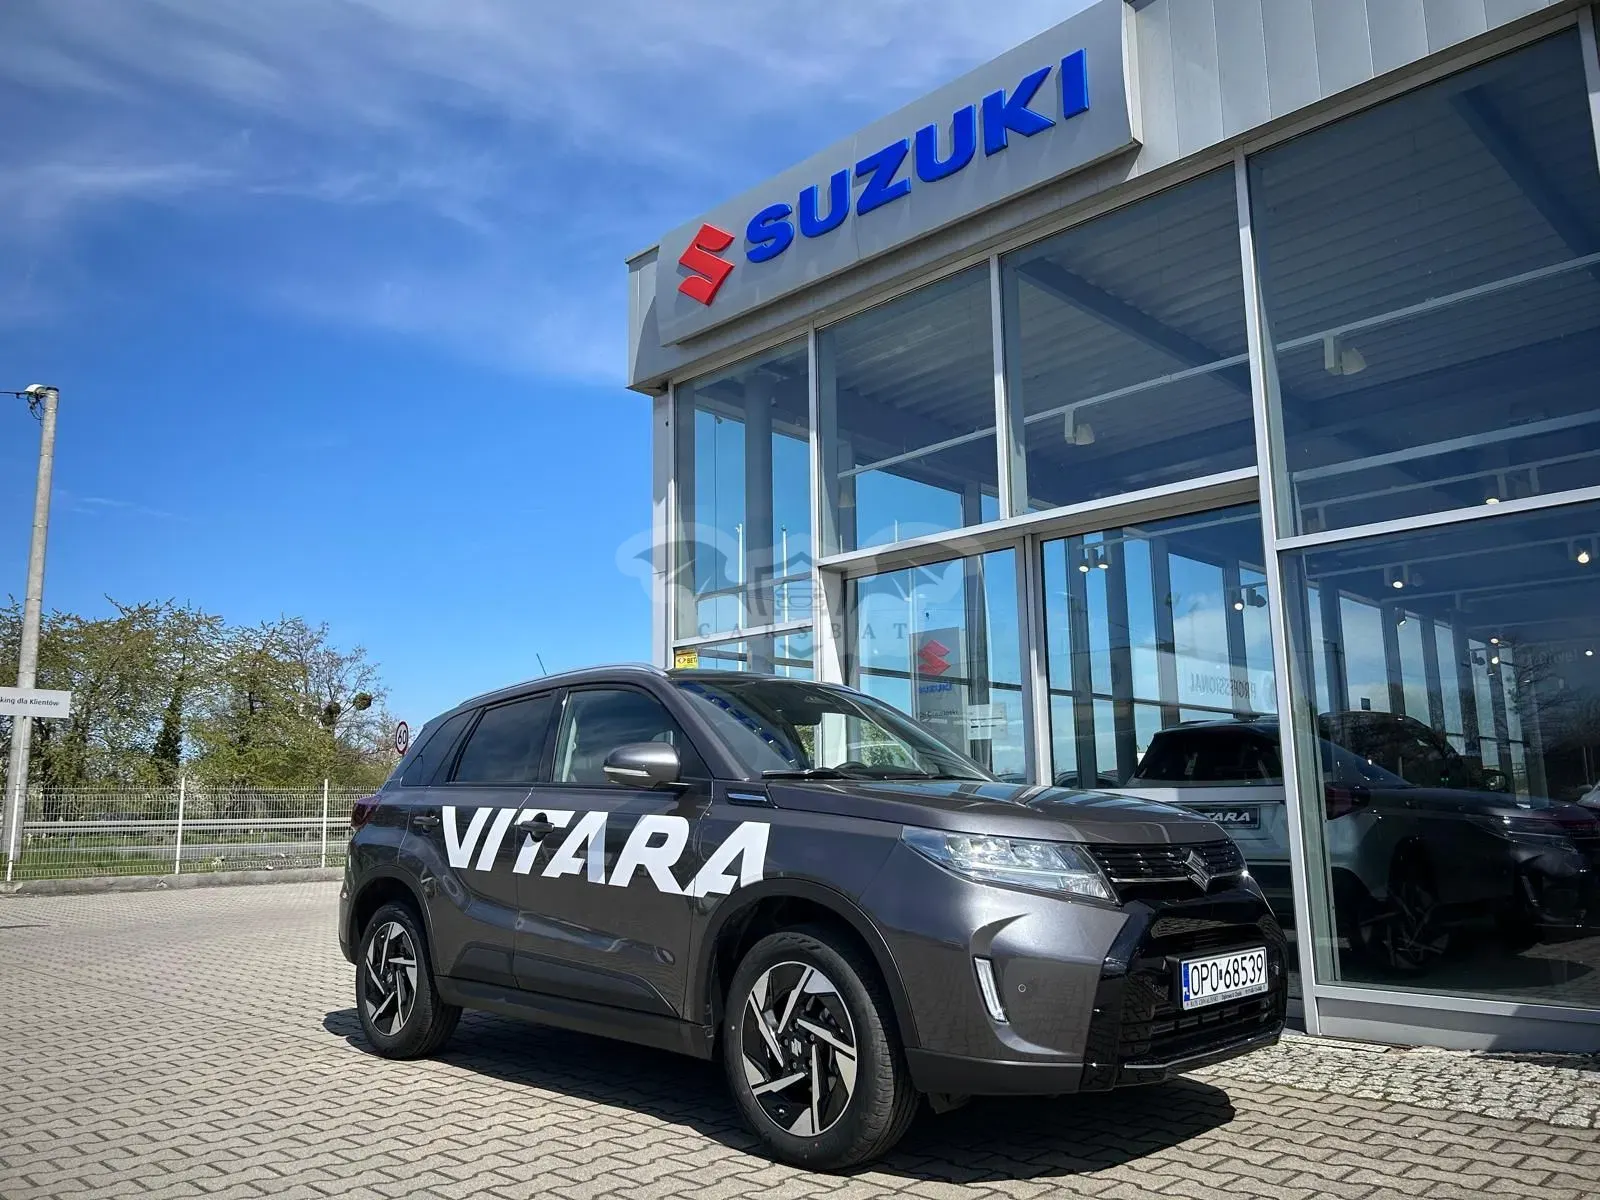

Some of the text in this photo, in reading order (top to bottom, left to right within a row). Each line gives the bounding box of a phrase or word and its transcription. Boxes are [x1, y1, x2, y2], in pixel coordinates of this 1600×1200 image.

[746, 48, 1090, 263] SUZUKI
[0, 696, 60, 706] king dla Klientów
[398, 729, 407, 745] 60
[1203, 811, 1251, 823] TARA
[442, 806, 771, 898] VITARA
[1223, 953, 1264, 989] 68539
